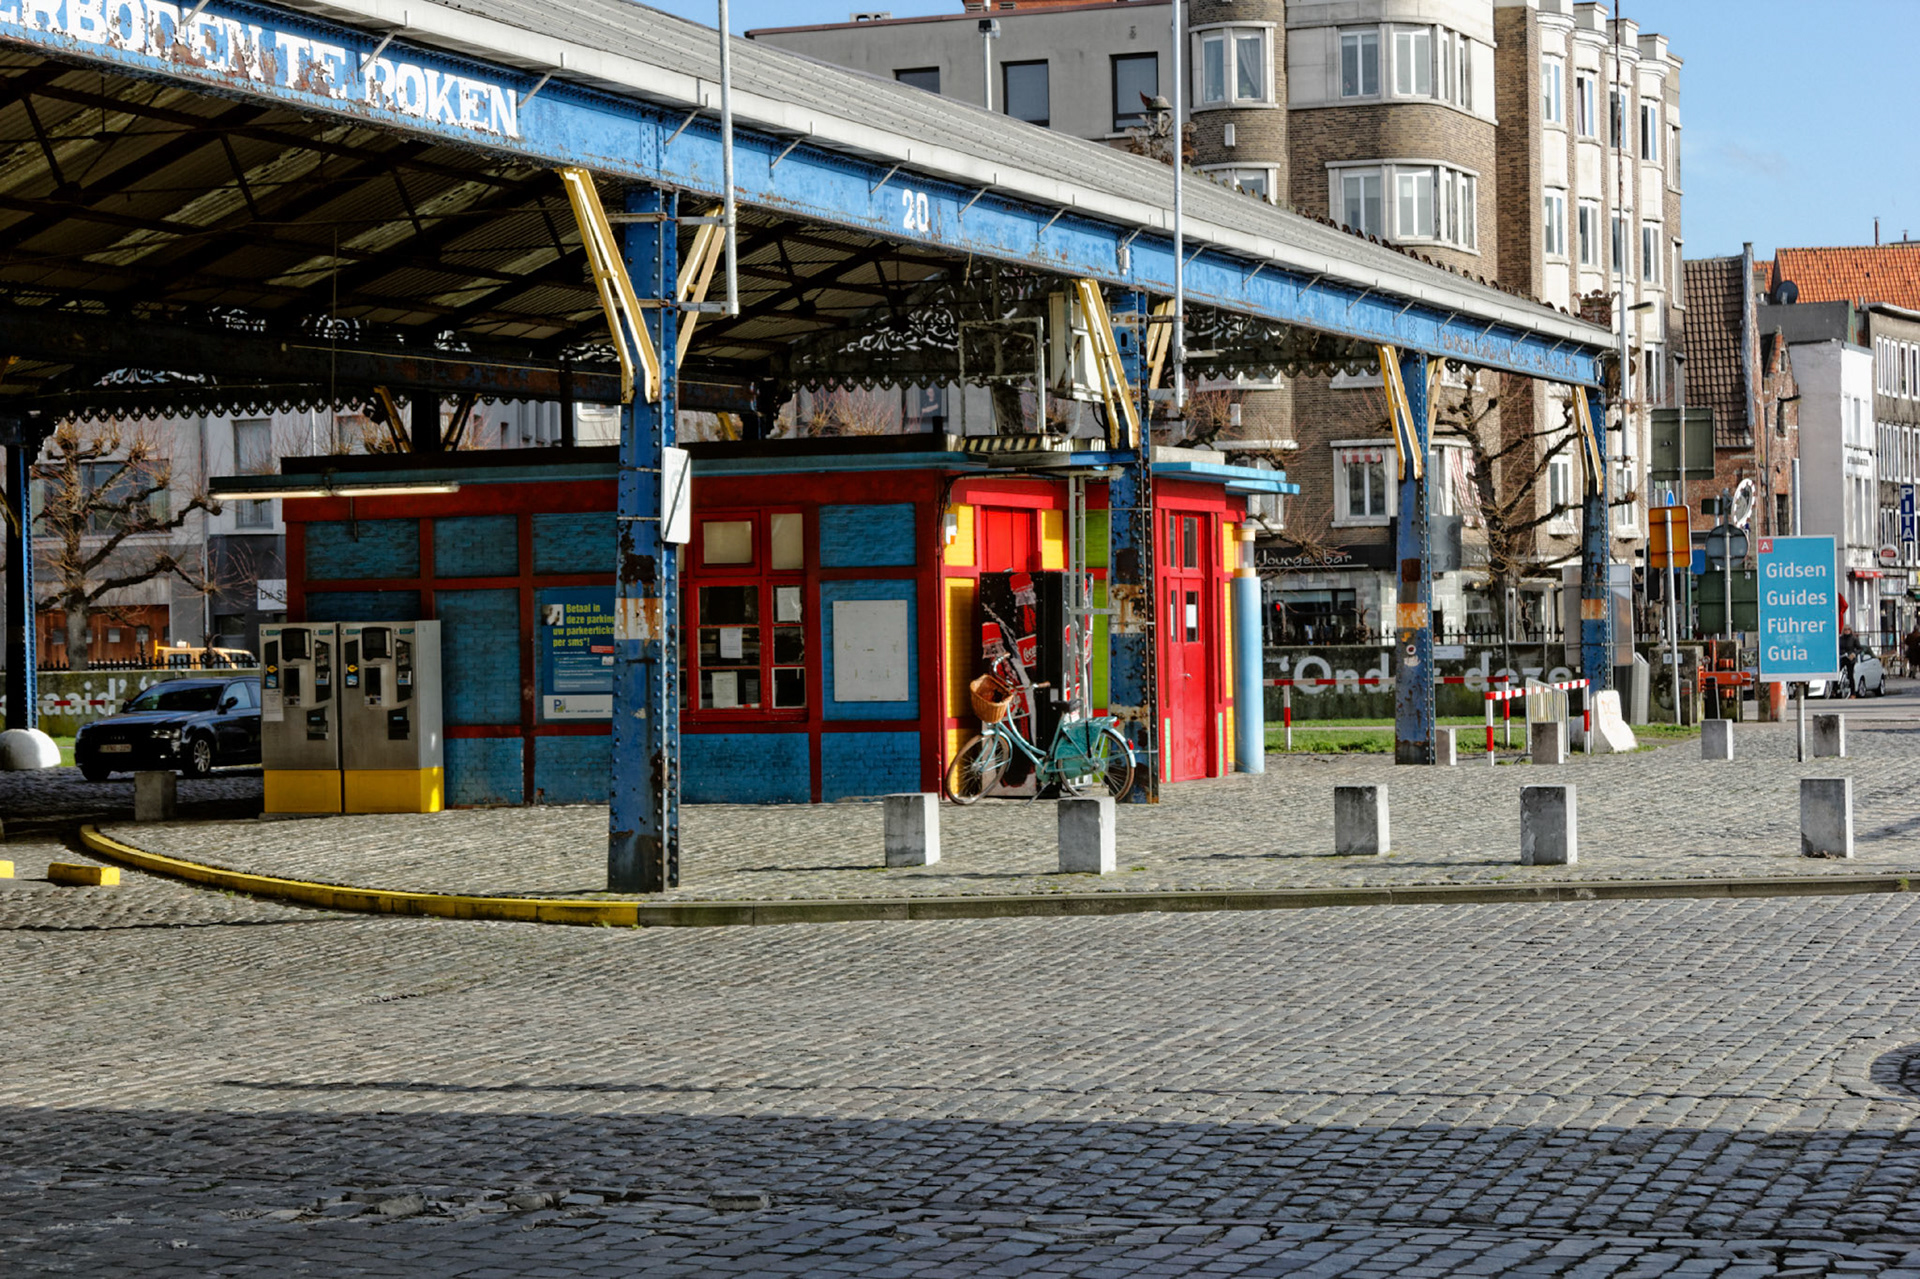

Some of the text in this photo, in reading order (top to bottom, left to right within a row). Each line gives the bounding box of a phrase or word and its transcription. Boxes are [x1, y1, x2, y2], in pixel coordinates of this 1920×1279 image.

[275, 31, 347, 99] TE
[360, 52, 519, 138] ROKEN
[902, 188, 929, 232] 20
[1901, 487, 1914, 539] PITA
[1761, 541, 1769, 550] A
[1766, 562, 1826, 579] Gidsen
[1767, 589, 1828, 606] Guides
[566, 604, 600, 613] Betaal in
[566, 615, 585, 624] deze
[1768, 617, 1827, 634] Führer
[553, 639, 565, 647] per
[1768, 645, 1808, 661] Guia
